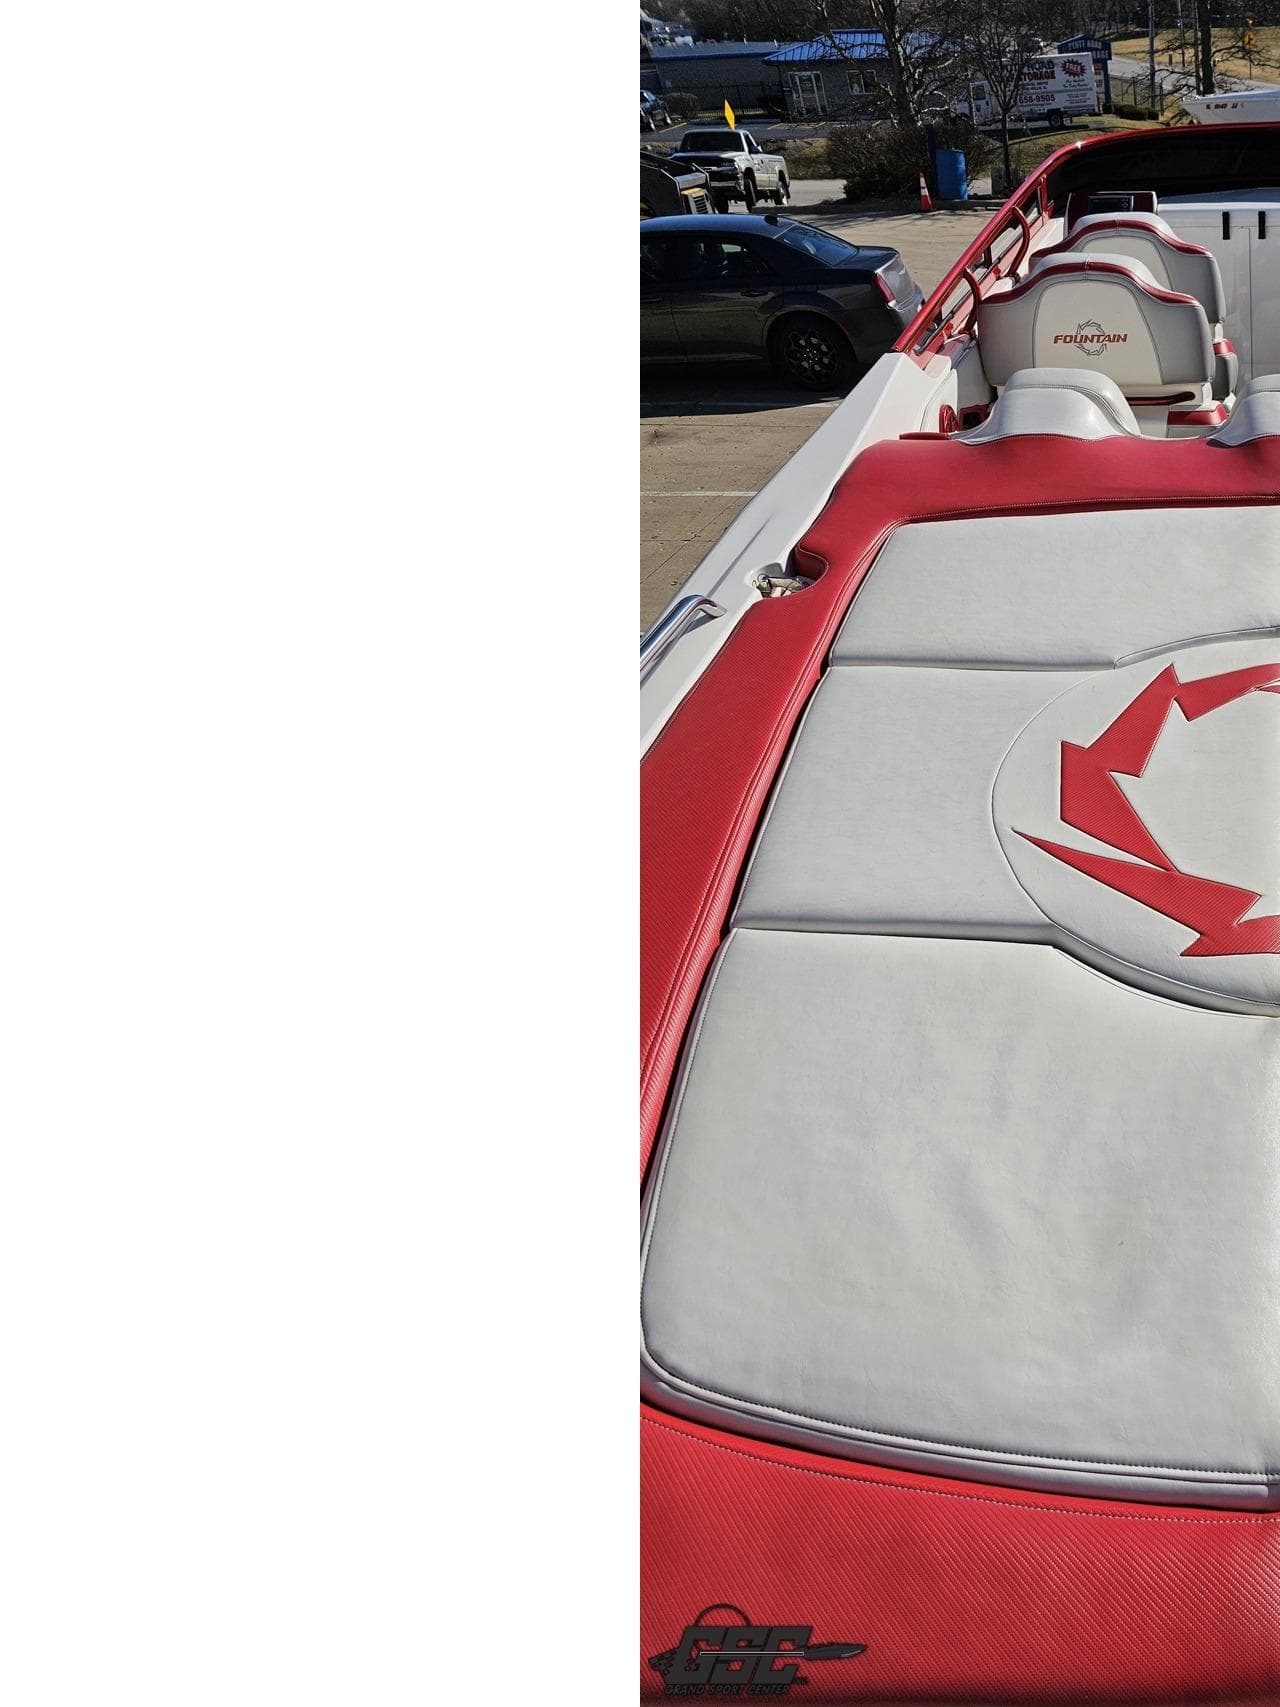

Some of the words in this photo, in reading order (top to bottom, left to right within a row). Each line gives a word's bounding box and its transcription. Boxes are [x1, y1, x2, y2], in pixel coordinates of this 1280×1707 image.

[1065, 63, 1081, 72] FREE
[1019, 95, 1056, 104] 658-9505
[1053, 333, 1128, 344] FOUNTAIN
